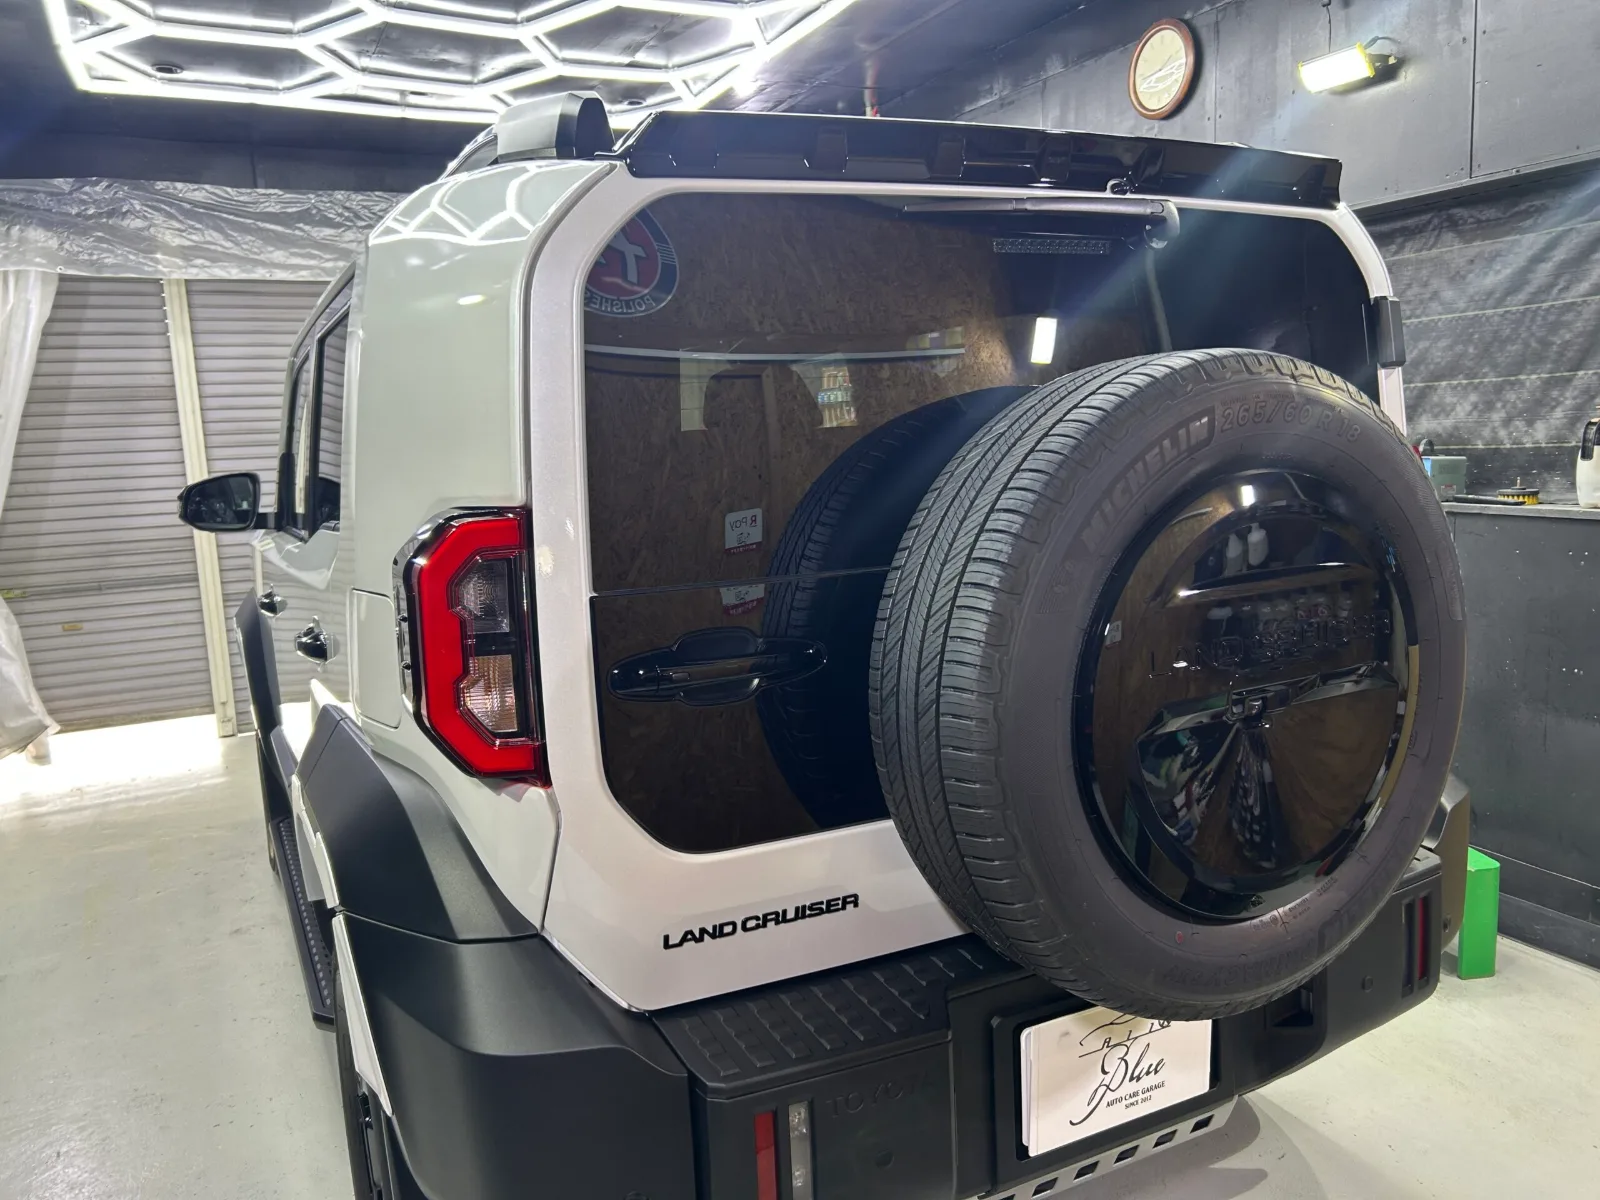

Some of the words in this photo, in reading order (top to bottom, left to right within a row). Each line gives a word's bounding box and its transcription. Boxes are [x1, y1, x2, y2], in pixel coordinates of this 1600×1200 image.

[1220, 400, 1313, 433] 265/60
[1314, 408, 1333, 432] R
[1336, 418, 1361, 443] 18
[1081, 415, 1210, 553] MICHELIN
[663, 921, 738, 950] LAND
[741, 893, 859, 933] CRUISER
[1105, 1095, 1123, 1109] AUTO
[1124, 1089, 1140, 1101] CARE
[1141, 1080, 1166, 1095] GARAGE
[1124, 1099, 1139, 1110] SINCE
